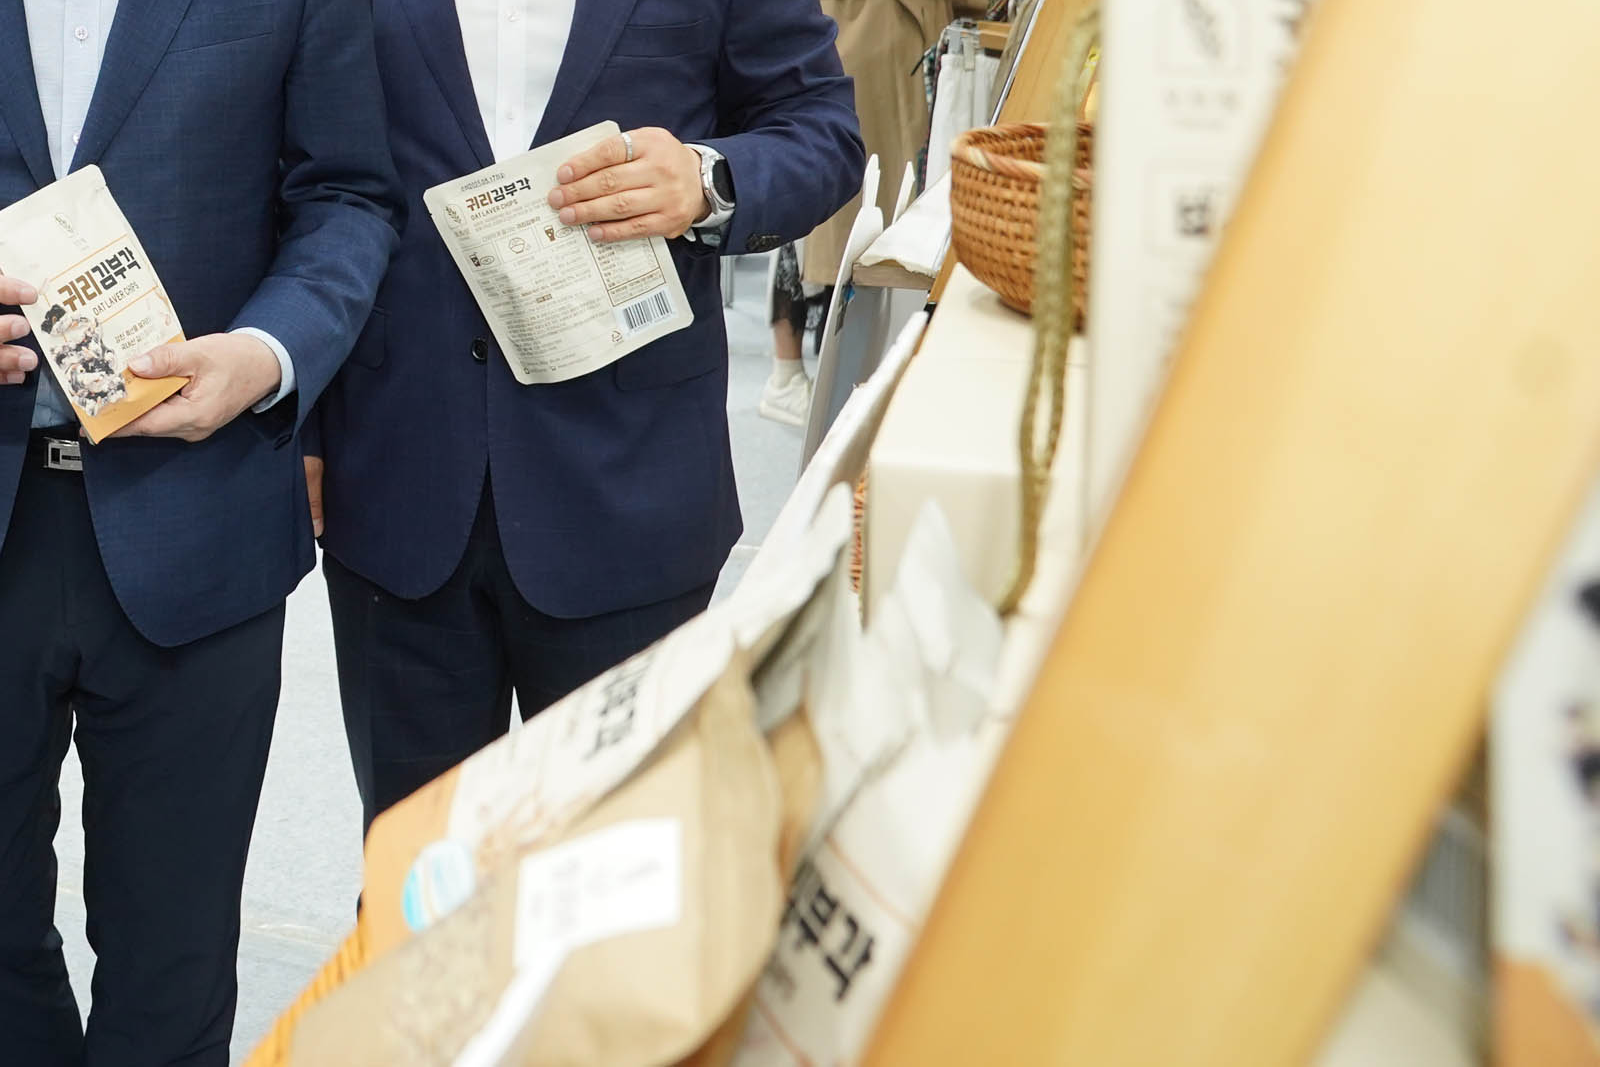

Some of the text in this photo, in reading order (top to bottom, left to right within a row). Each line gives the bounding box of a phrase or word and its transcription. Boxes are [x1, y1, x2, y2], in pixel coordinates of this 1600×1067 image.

[465, 177, 532, 212] 귀리김부각
[57, 247, 142, 312] 귀리김부각
[92, 303, 107, 316] OAT
[105, 290, 128, 311] LAVER
